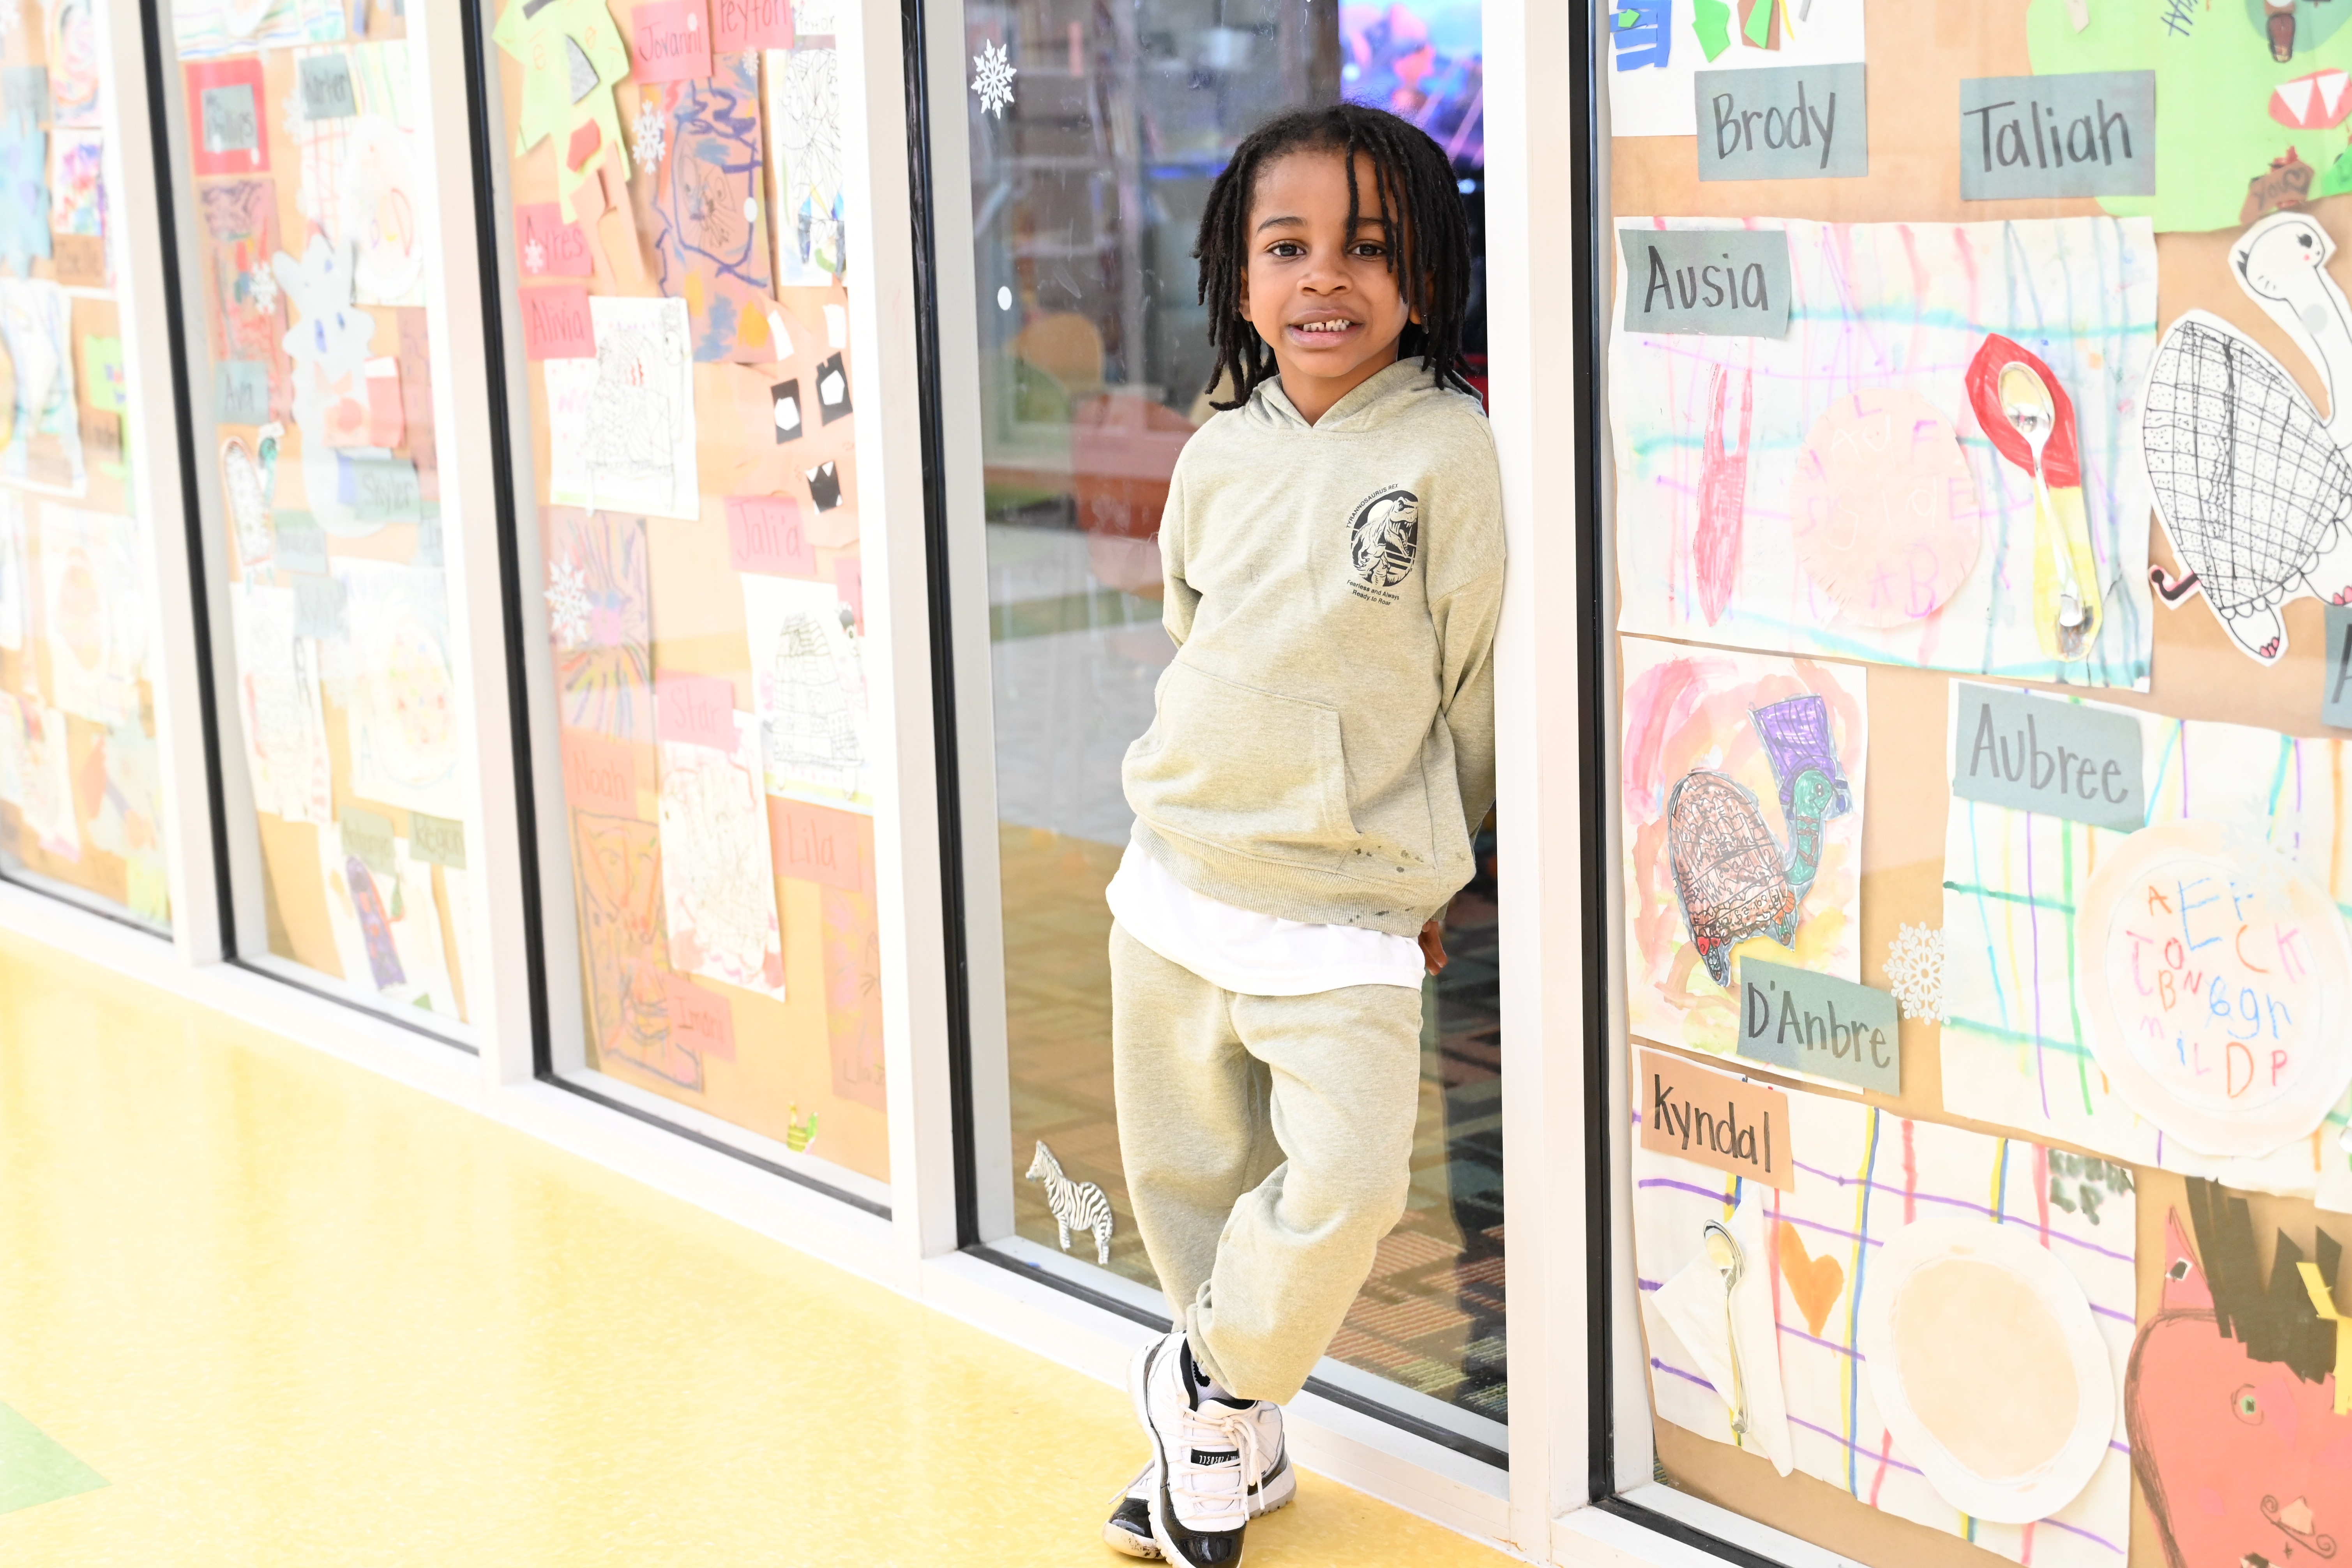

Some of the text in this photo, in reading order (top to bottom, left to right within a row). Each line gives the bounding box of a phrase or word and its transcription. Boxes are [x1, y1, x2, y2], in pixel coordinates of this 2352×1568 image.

[1713, 81, 1836, 170] Brody
[1963, 99, 2132, 172] Taliah
[1644, 245, 1769, 313] Ausia
[531, 299, 584, 345] Alivia
[363, 469, 414, 515] Skyler
[1346, 487, 1387, 528] TYRANNOSAURUS
[1347, 580, 1370, 592] Fearless
[1383, 592, 1399, 600] Always
[1353, 590, 1370, 600] Ready
[671, 682, 720, 734] Star
[573, 749, 627, 802] Noah
[1969, 703, 2129, 804] Aubree
[786, 814, 837, 871] Lila
[674, 995, 725, 1044] Imani
[1748, 980, 1891, 1069] D'Anbre
[1654, 1074, 1771, 1174] Kyndal
